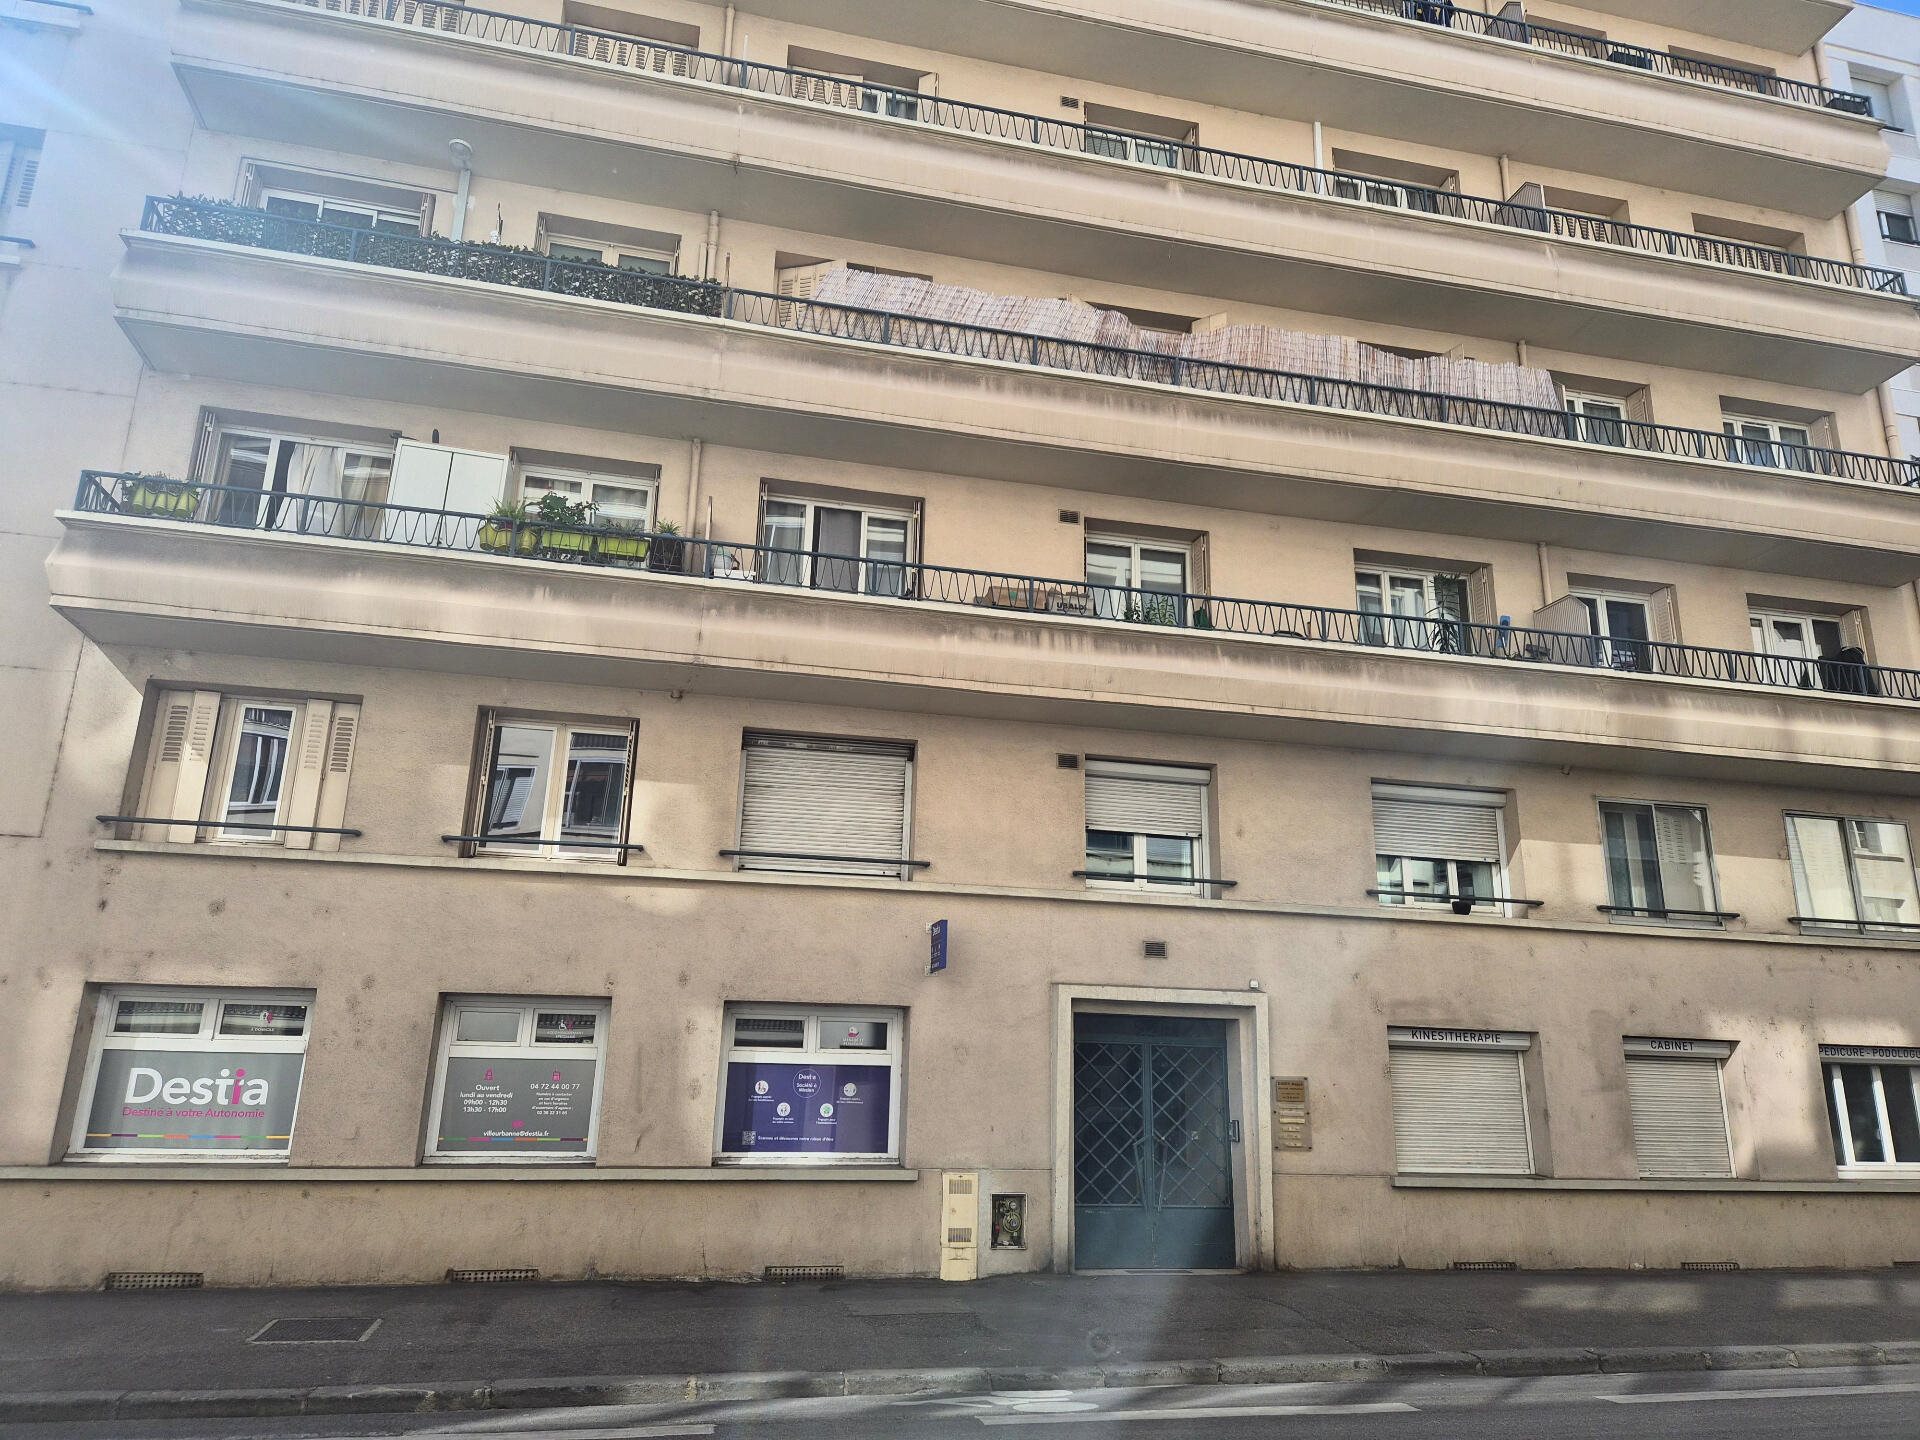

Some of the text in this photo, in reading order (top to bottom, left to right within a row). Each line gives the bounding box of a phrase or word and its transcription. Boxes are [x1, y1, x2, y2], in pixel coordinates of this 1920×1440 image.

[1411, 1029, 1502, 1044] KINESITHERAPIE
[1650, 1040, 1695, 1051] CABINET
[1819, 1046, 1865, 1057] PEDICURE
[124, 1067, 269, 1106] Destia
[122, 1106, 265, 1118] Destiné à votre Autonomie
